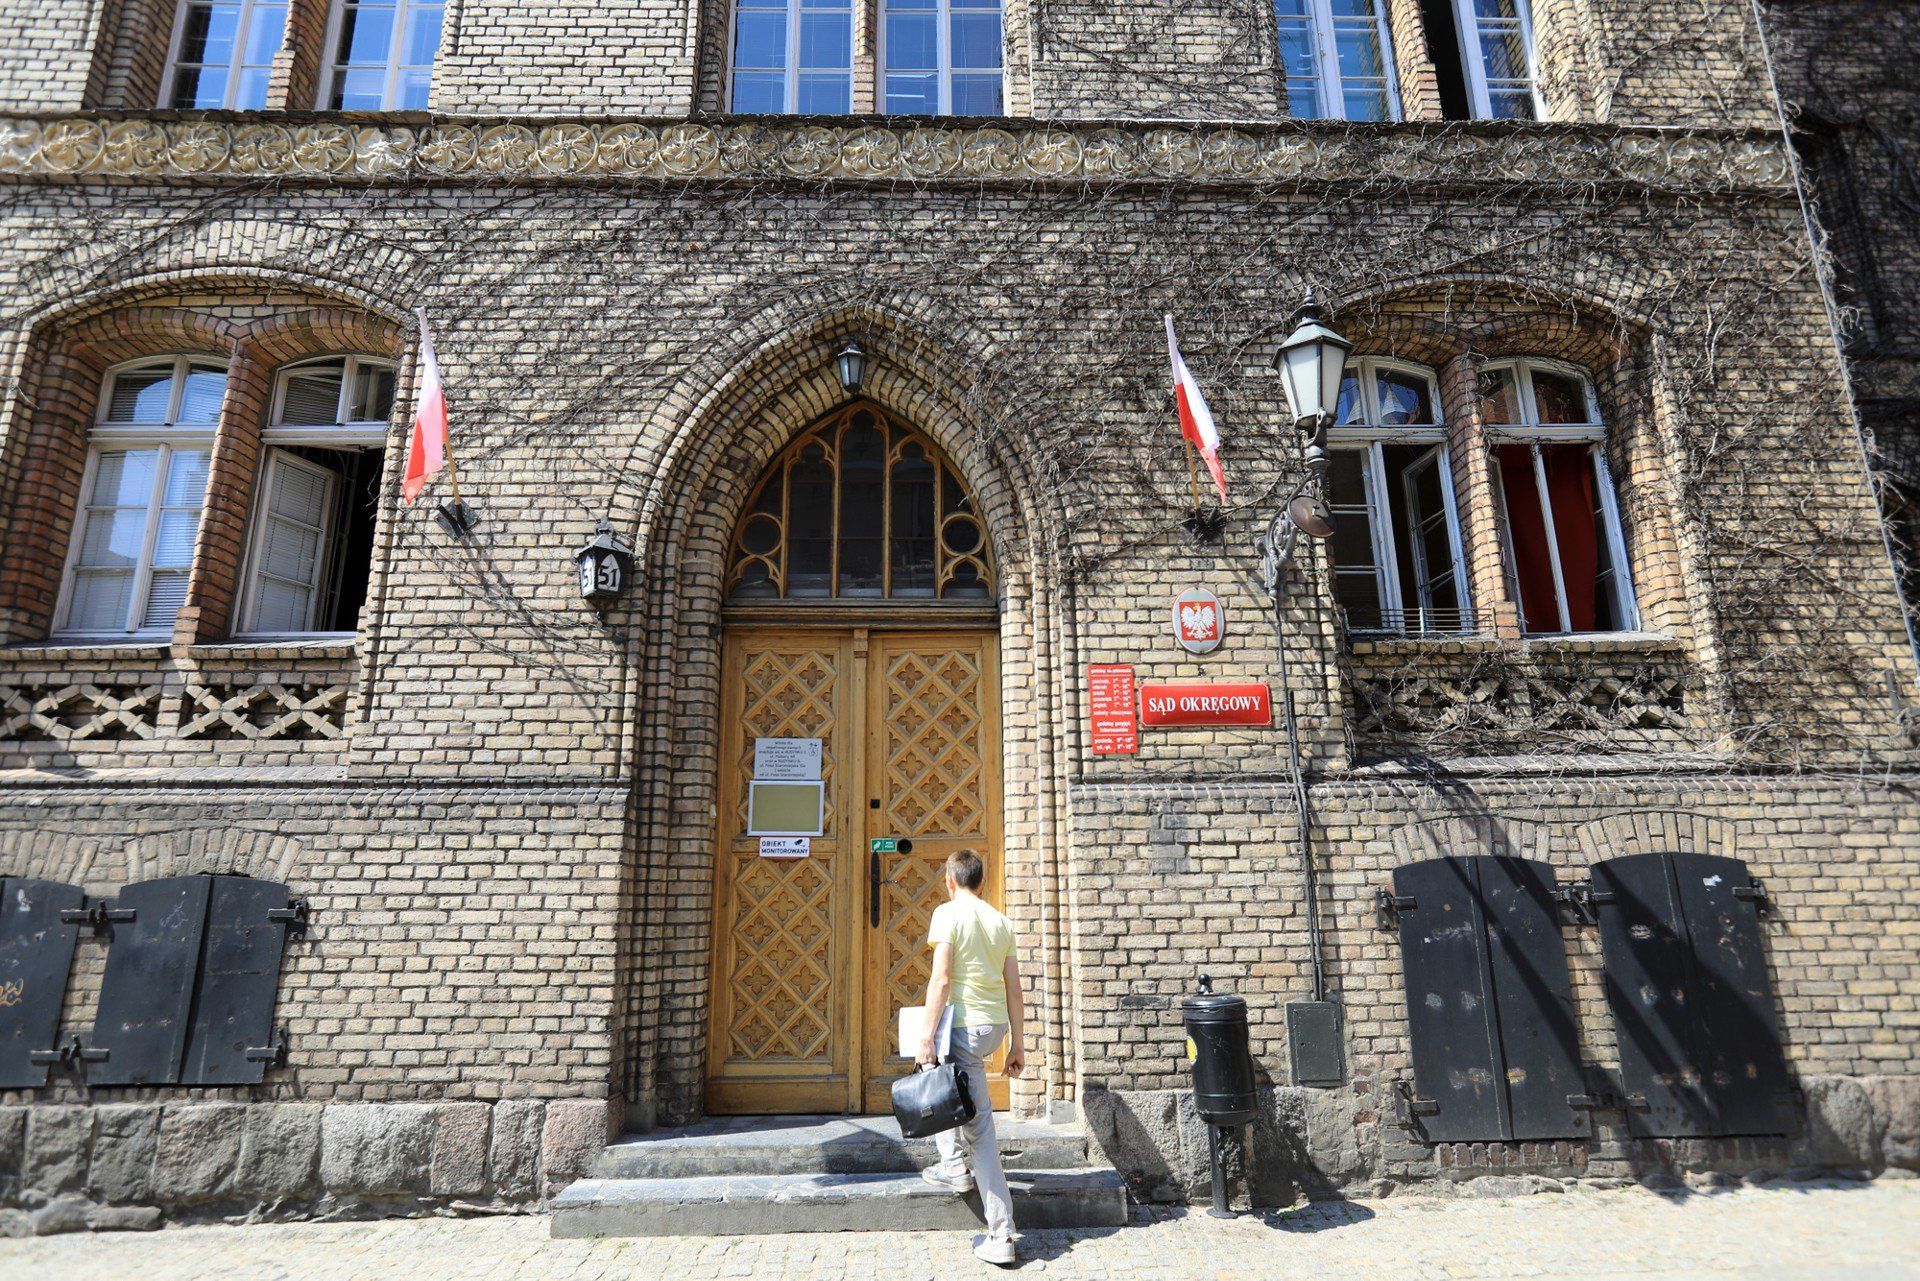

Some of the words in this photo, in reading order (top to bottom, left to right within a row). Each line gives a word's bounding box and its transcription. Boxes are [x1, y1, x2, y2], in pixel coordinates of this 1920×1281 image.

[598, 565, 617, 587] 51
[1149, 697, 1176, 715] SĄD
[1180, 696, 1260, 714] OKRĘGOWY
